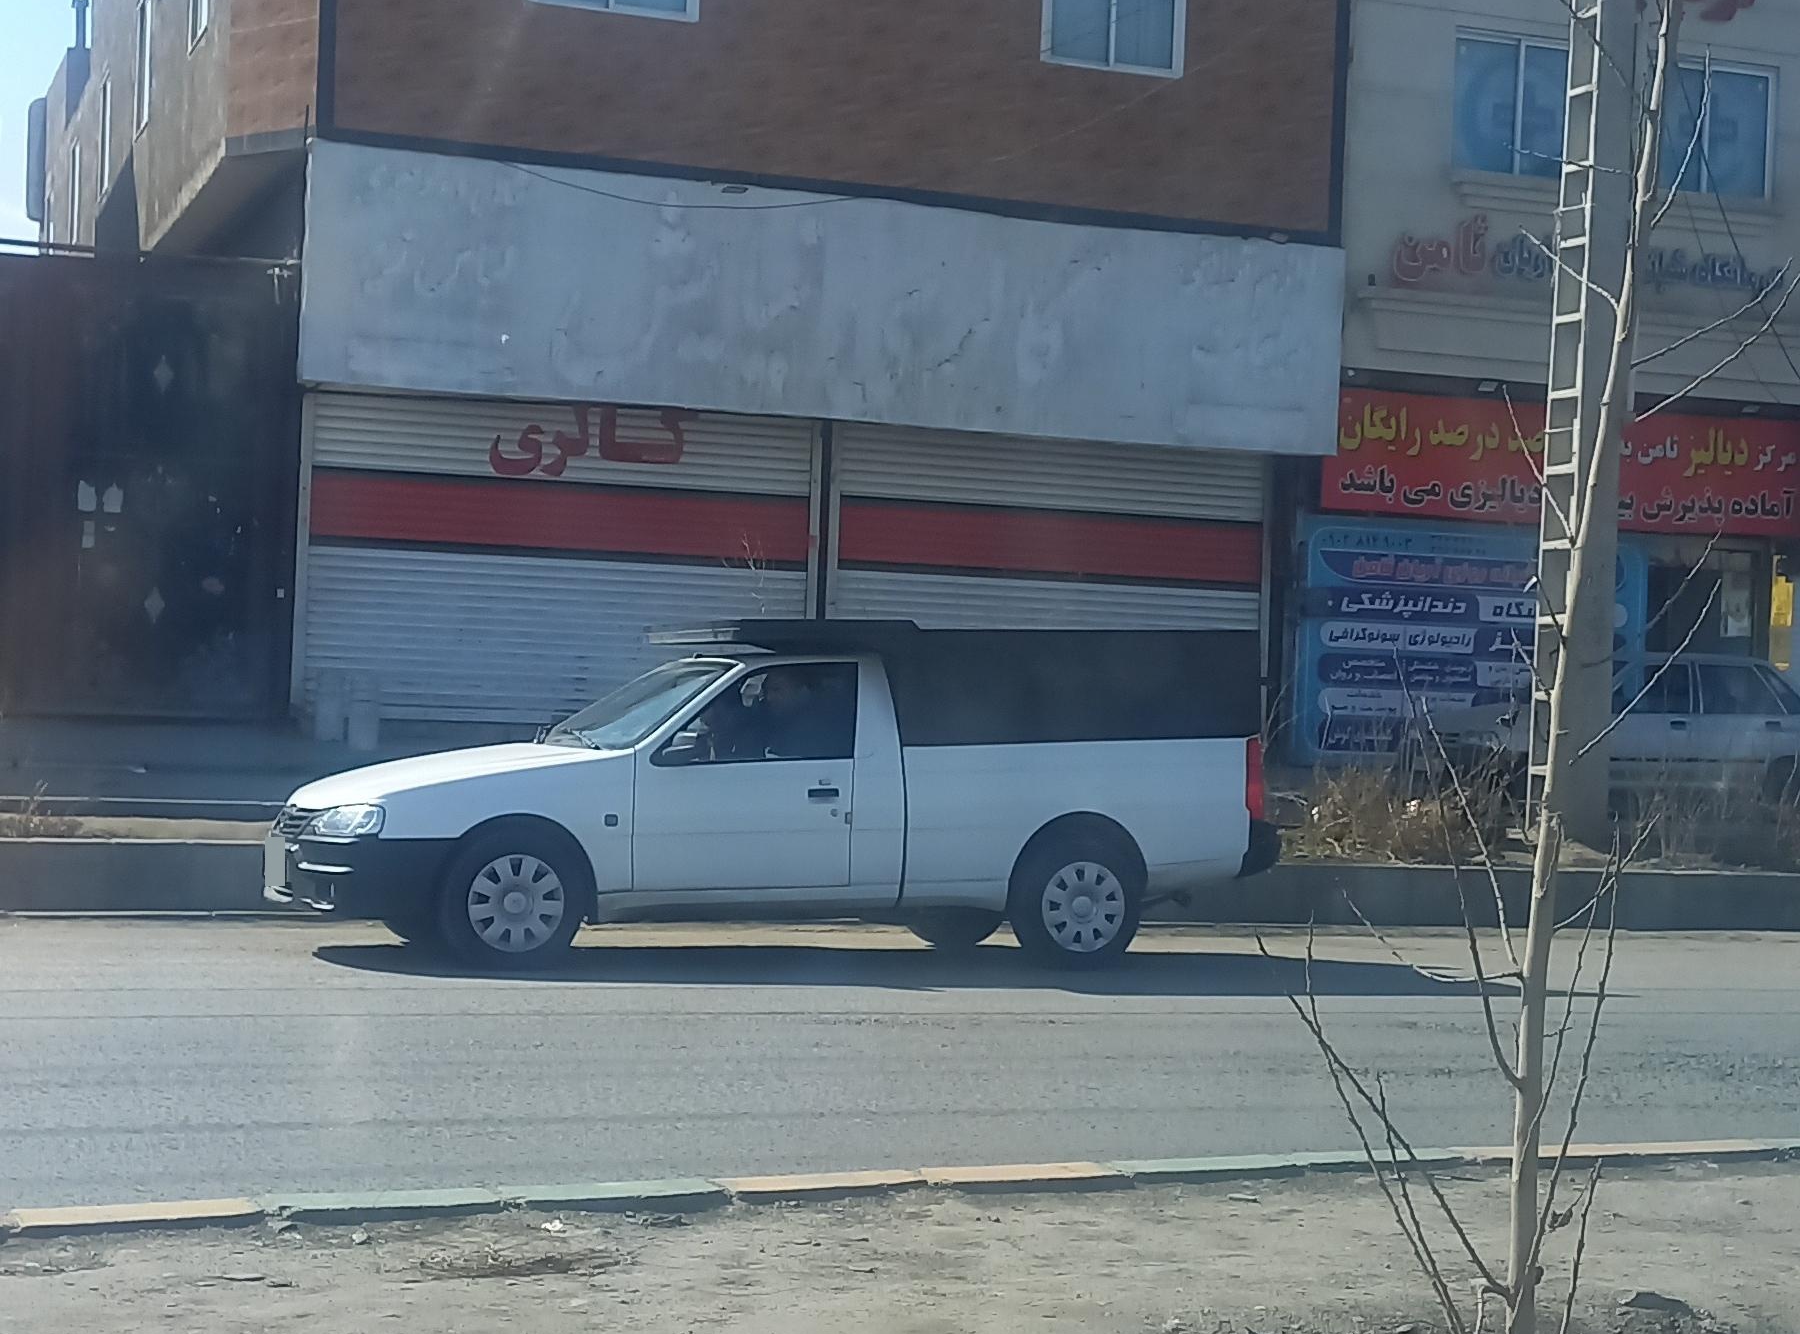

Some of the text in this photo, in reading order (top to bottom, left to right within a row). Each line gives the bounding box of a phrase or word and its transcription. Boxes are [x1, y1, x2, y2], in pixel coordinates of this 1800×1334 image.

[1392, 212, 1489, 283] ثامن
[1339, 402, 1421, 457] رایگان
[1637, 435, 1679, 465] ثامن
[1682, 426, 1749, 478] دیالیز
[1752, 443, 1797, 472] مرکز
[1339, 464, 1398, 504] باشد
[1402, 480, 1443, 507] می
[1449, 474, 1543, 512] دیالیزی
[1640, 486, 1726, 528] پذیرش
[1730, 487, 1797, 520] آماده
[1341, 590, 1468, 619] دندانپزشکی
[1328, 626, 1401, 644] سونوگرافی
[1408, 628, 1474, 648] رادیولوژی
